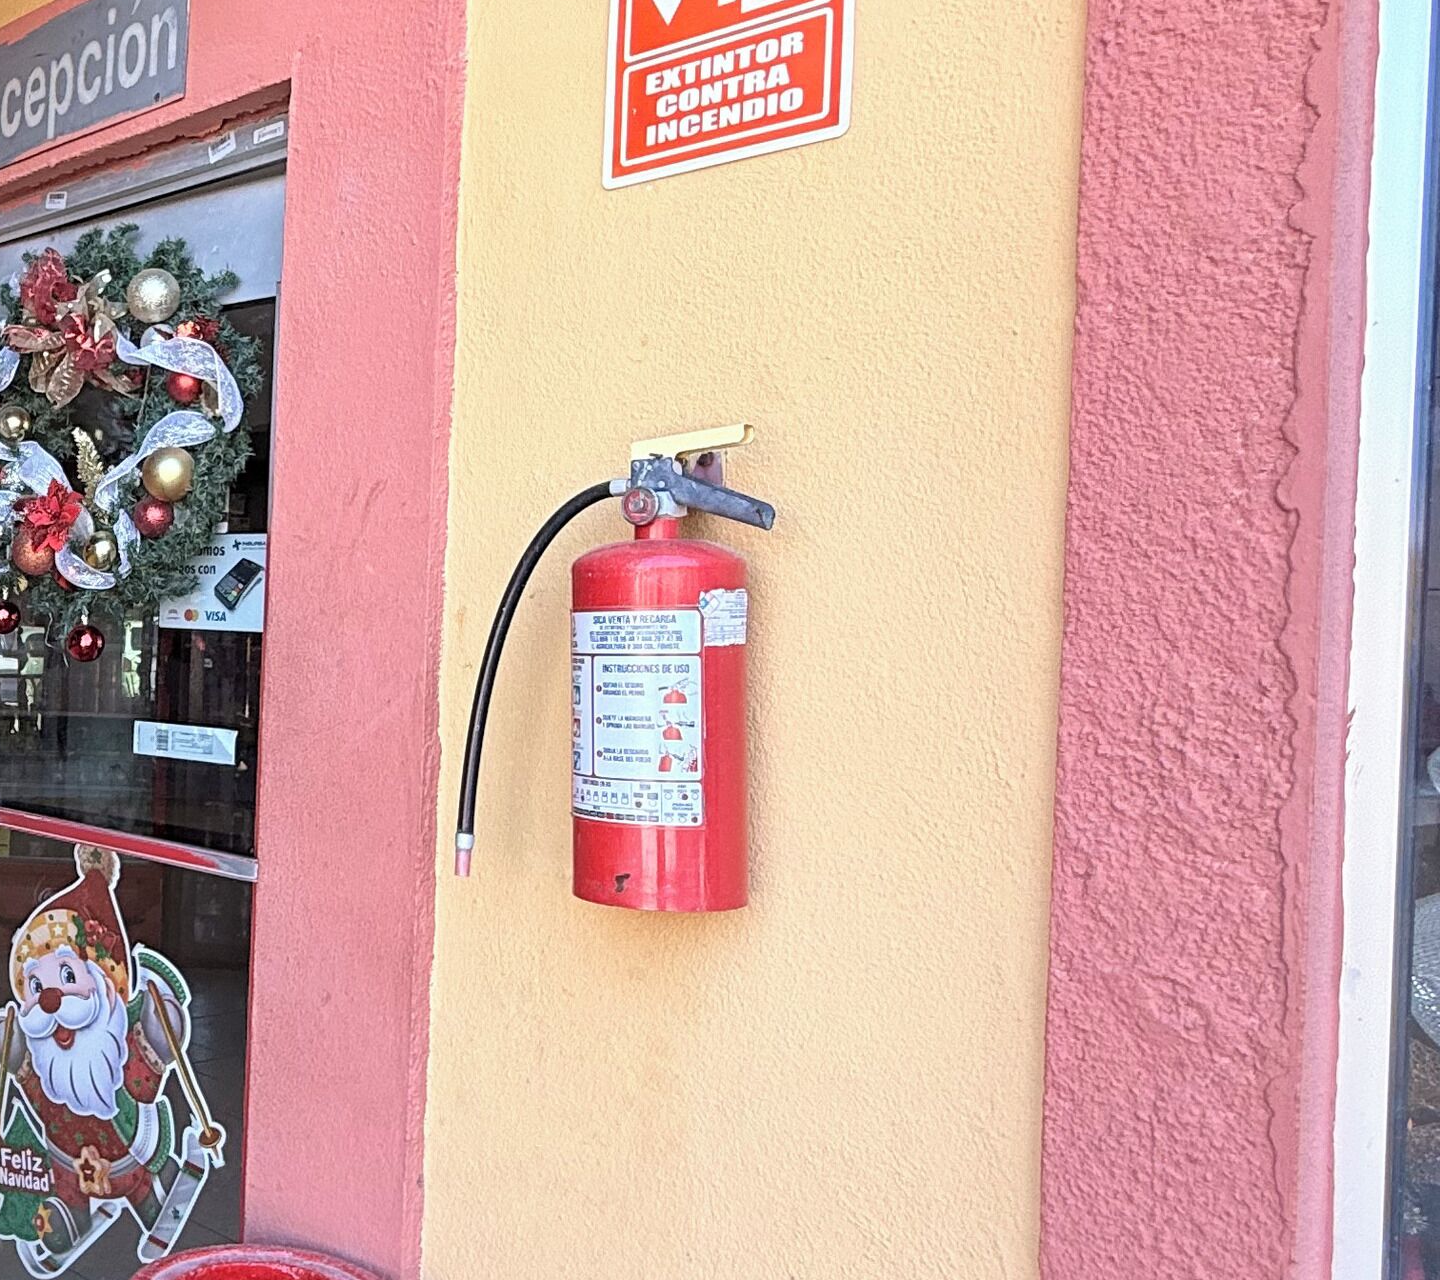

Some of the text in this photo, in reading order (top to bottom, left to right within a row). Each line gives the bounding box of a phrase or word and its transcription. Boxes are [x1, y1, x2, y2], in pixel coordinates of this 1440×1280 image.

[645, 31, 804, 97] EXTINTOR
[655, 62, 791, 119] CONTRA
[645, 86, 804, 147] INCENDIO
[198, 565, 216, 575] con
[205, 610, 227, 622] VISA
[640, 615, 677, 624] RECARGA
[602, 664, 690, 674] INSTRUCCIONES DE USO
[0, 1147, 43, 1172] Feliz
